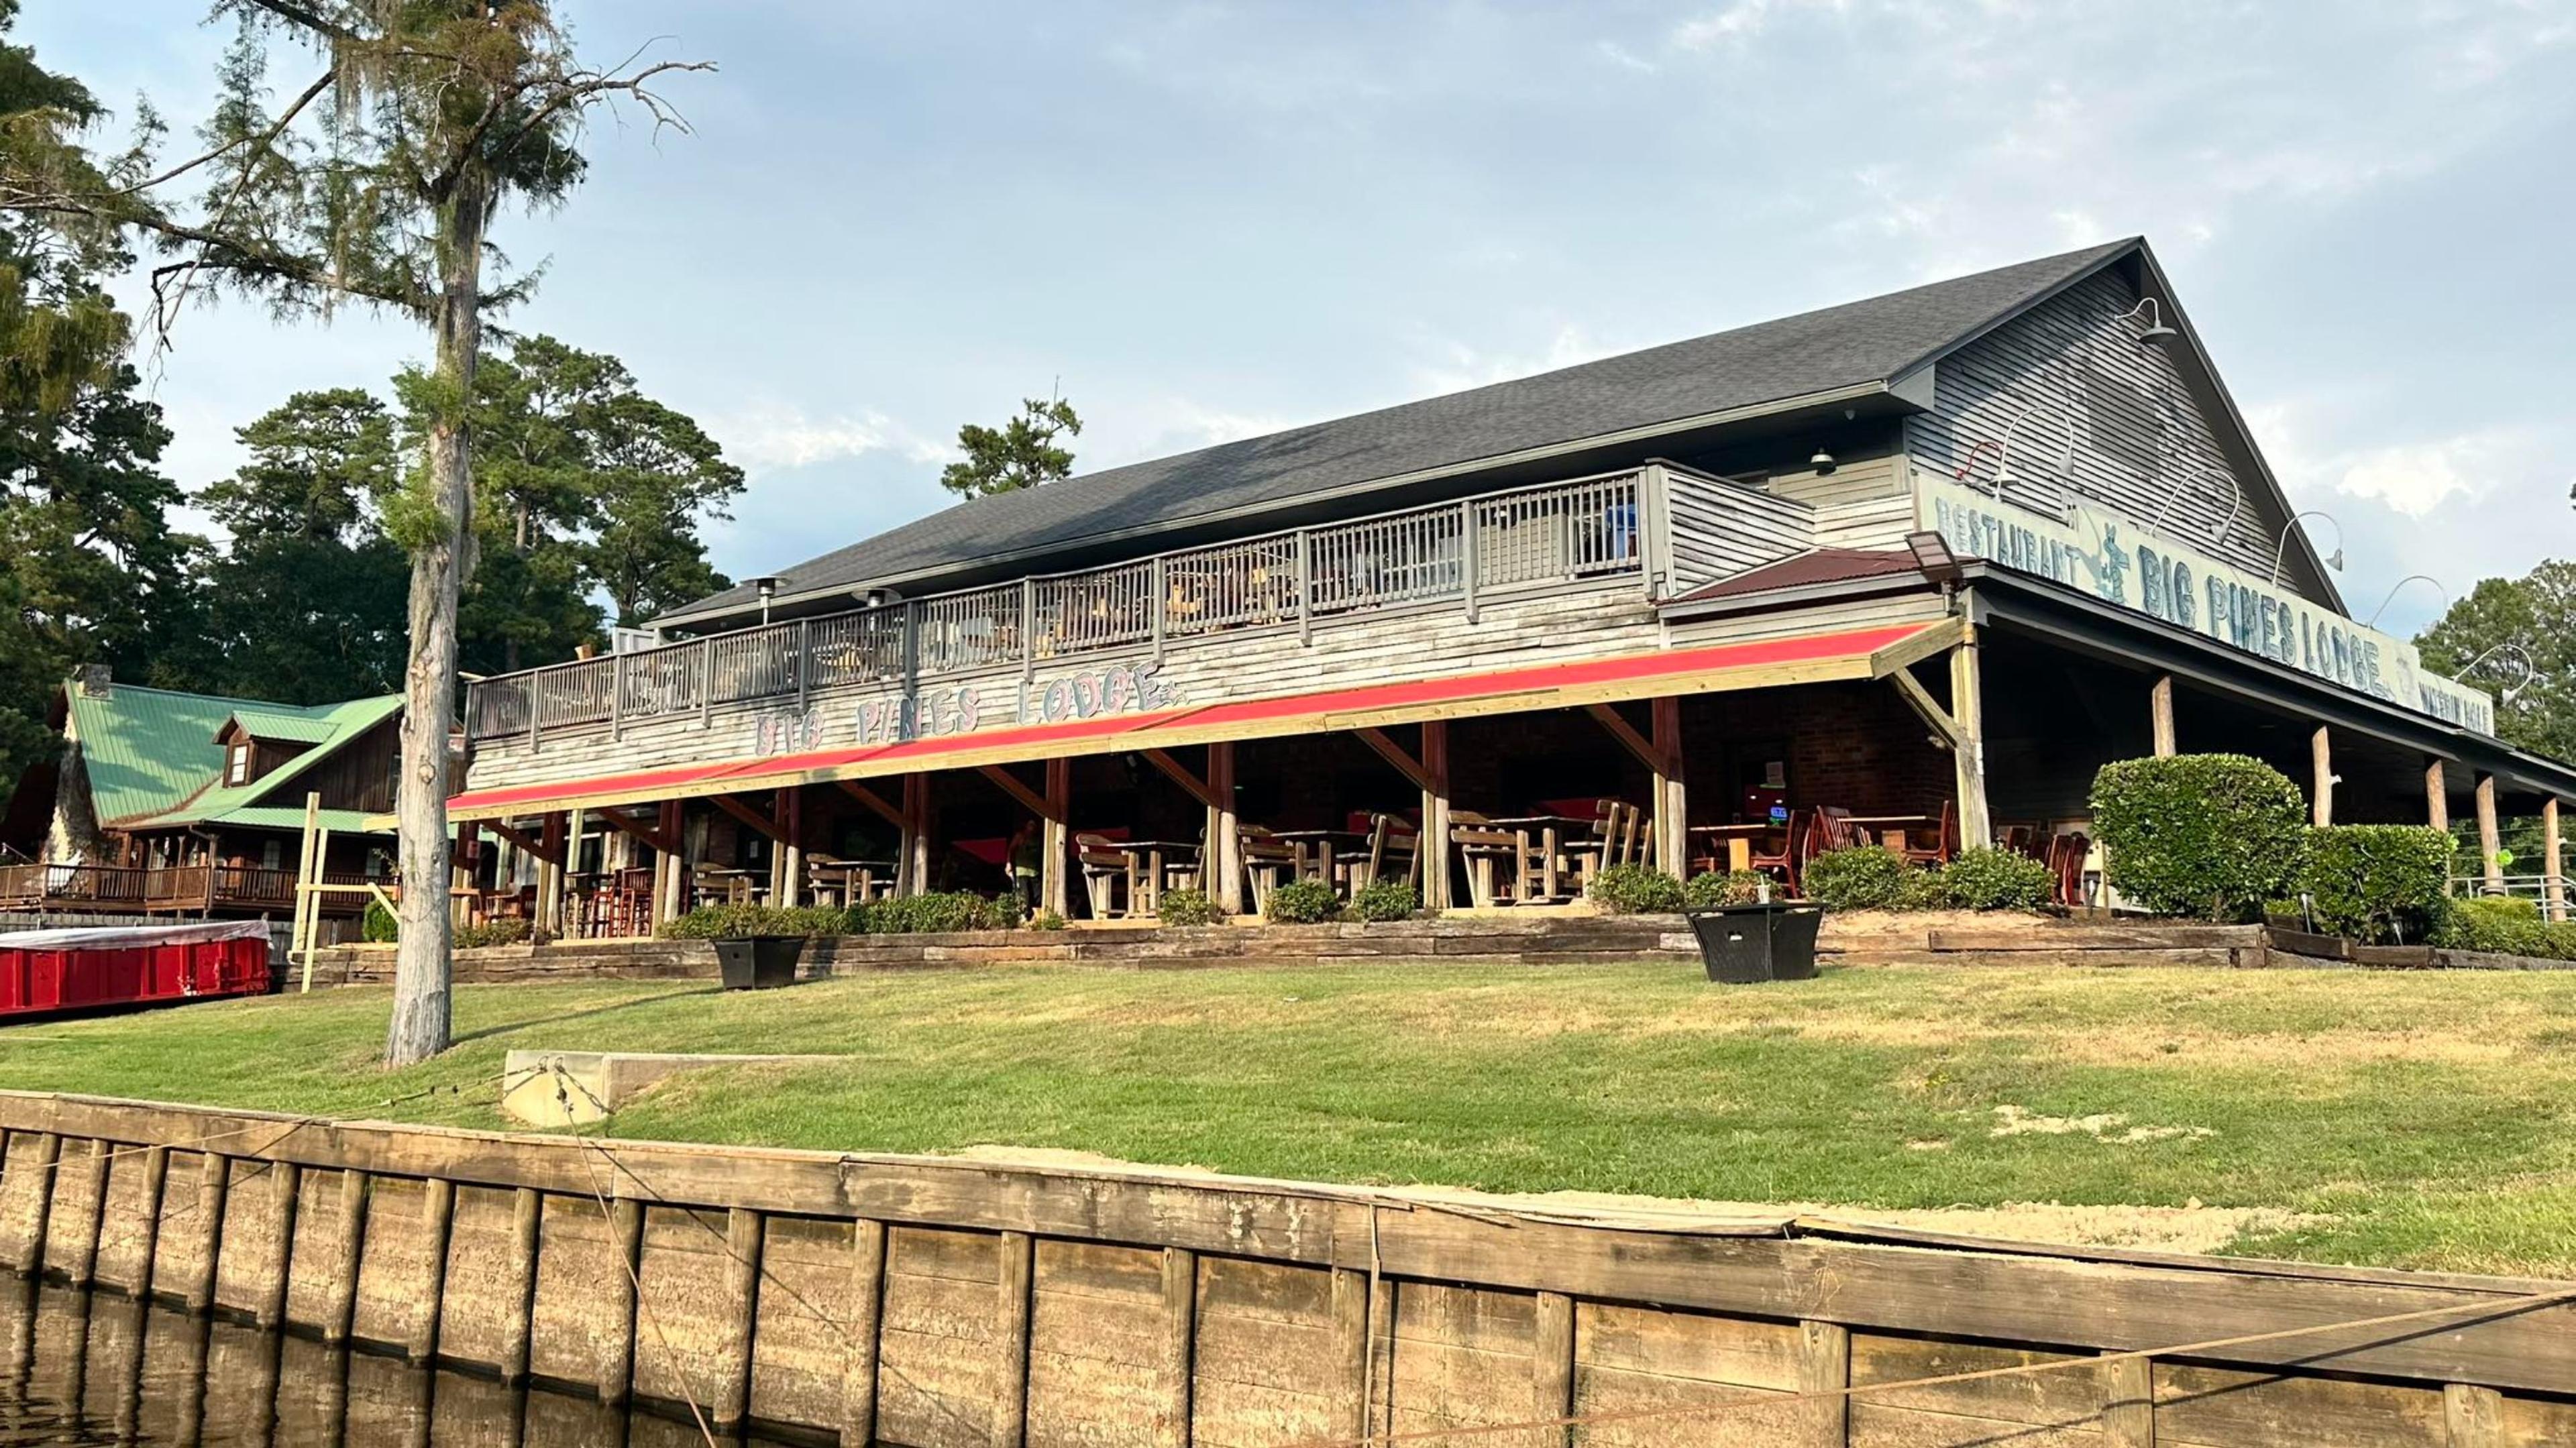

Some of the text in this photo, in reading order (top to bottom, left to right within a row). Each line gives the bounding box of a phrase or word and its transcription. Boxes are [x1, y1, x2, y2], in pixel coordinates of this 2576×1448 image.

[1935, 496, 2081, 585] RESTAURANT
[2137, 544, 2391, 701] BIG PINES LODGE
[755, 660, 1162, 757] BIG PINES LODGE
